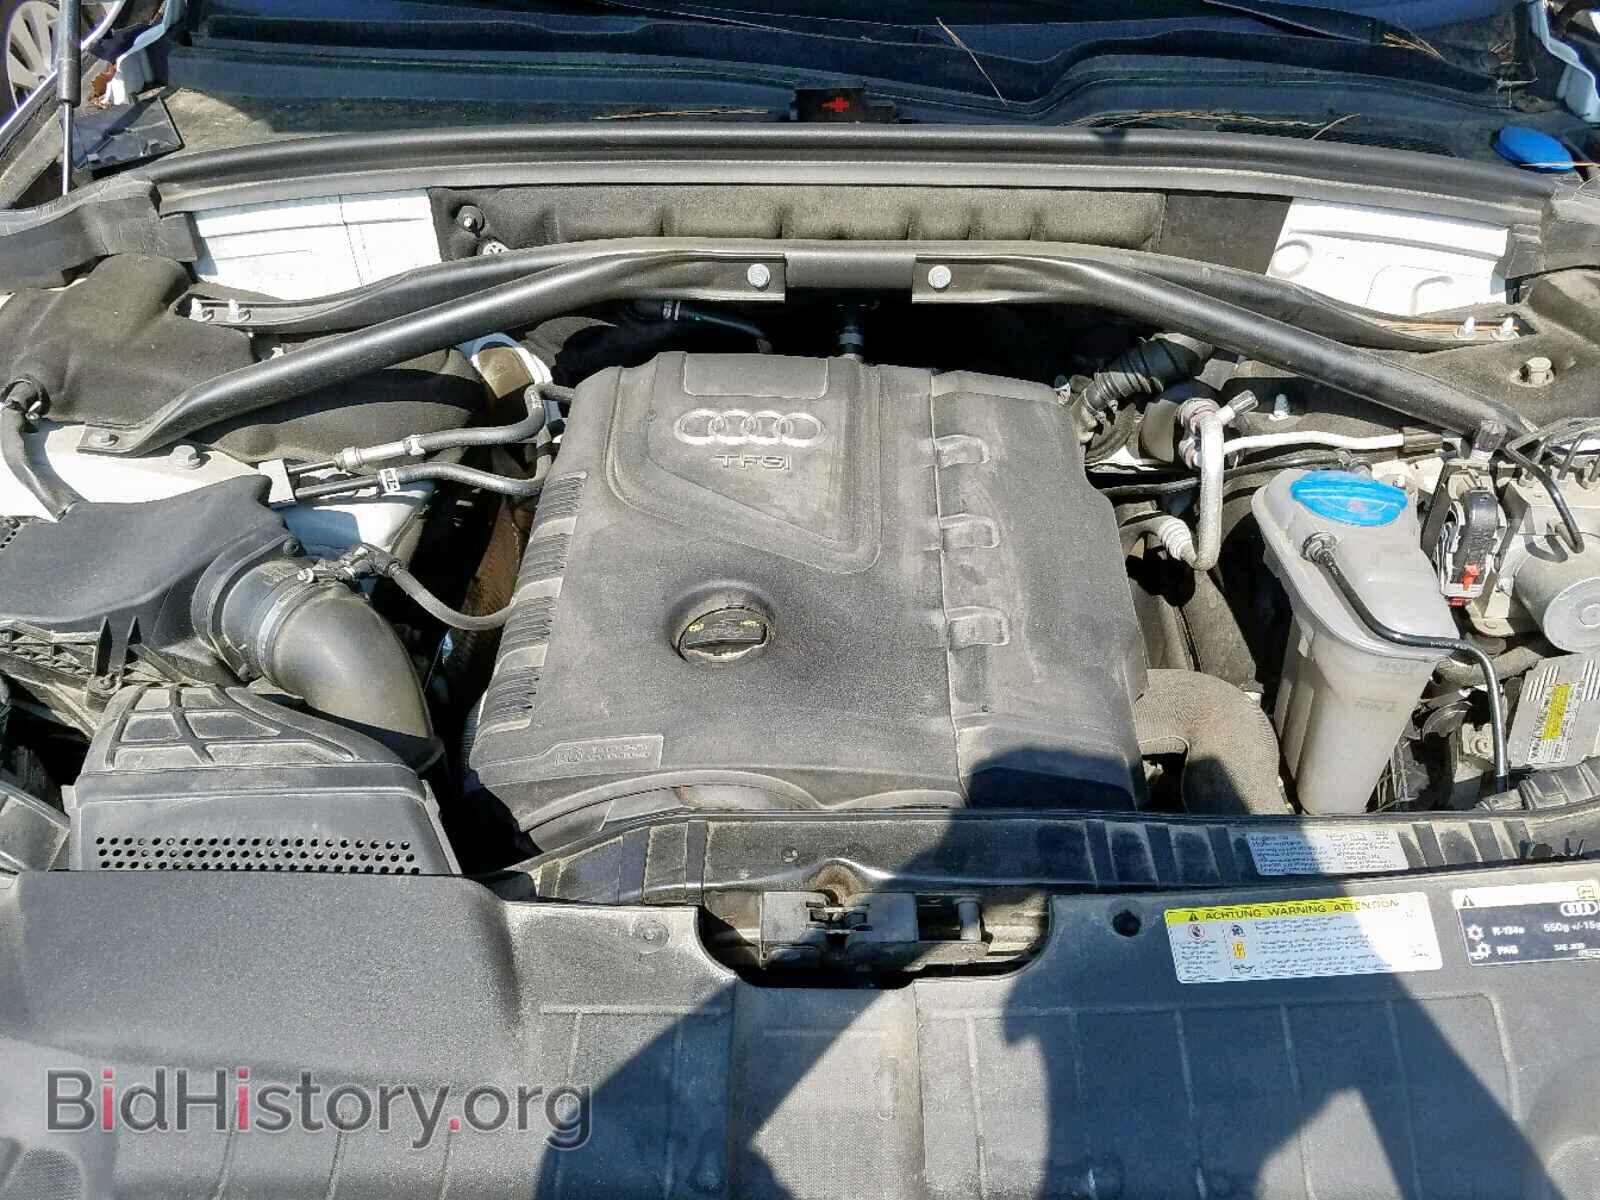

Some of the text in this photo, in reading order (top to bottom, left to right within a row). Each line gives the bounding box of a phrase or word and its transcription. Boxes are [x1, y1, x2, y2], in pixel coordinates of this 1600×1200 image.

[713, 453, 791, 471] TFSI
[1205, 899, 1400, 920] ACHTUNG WARNING ATTENTION
